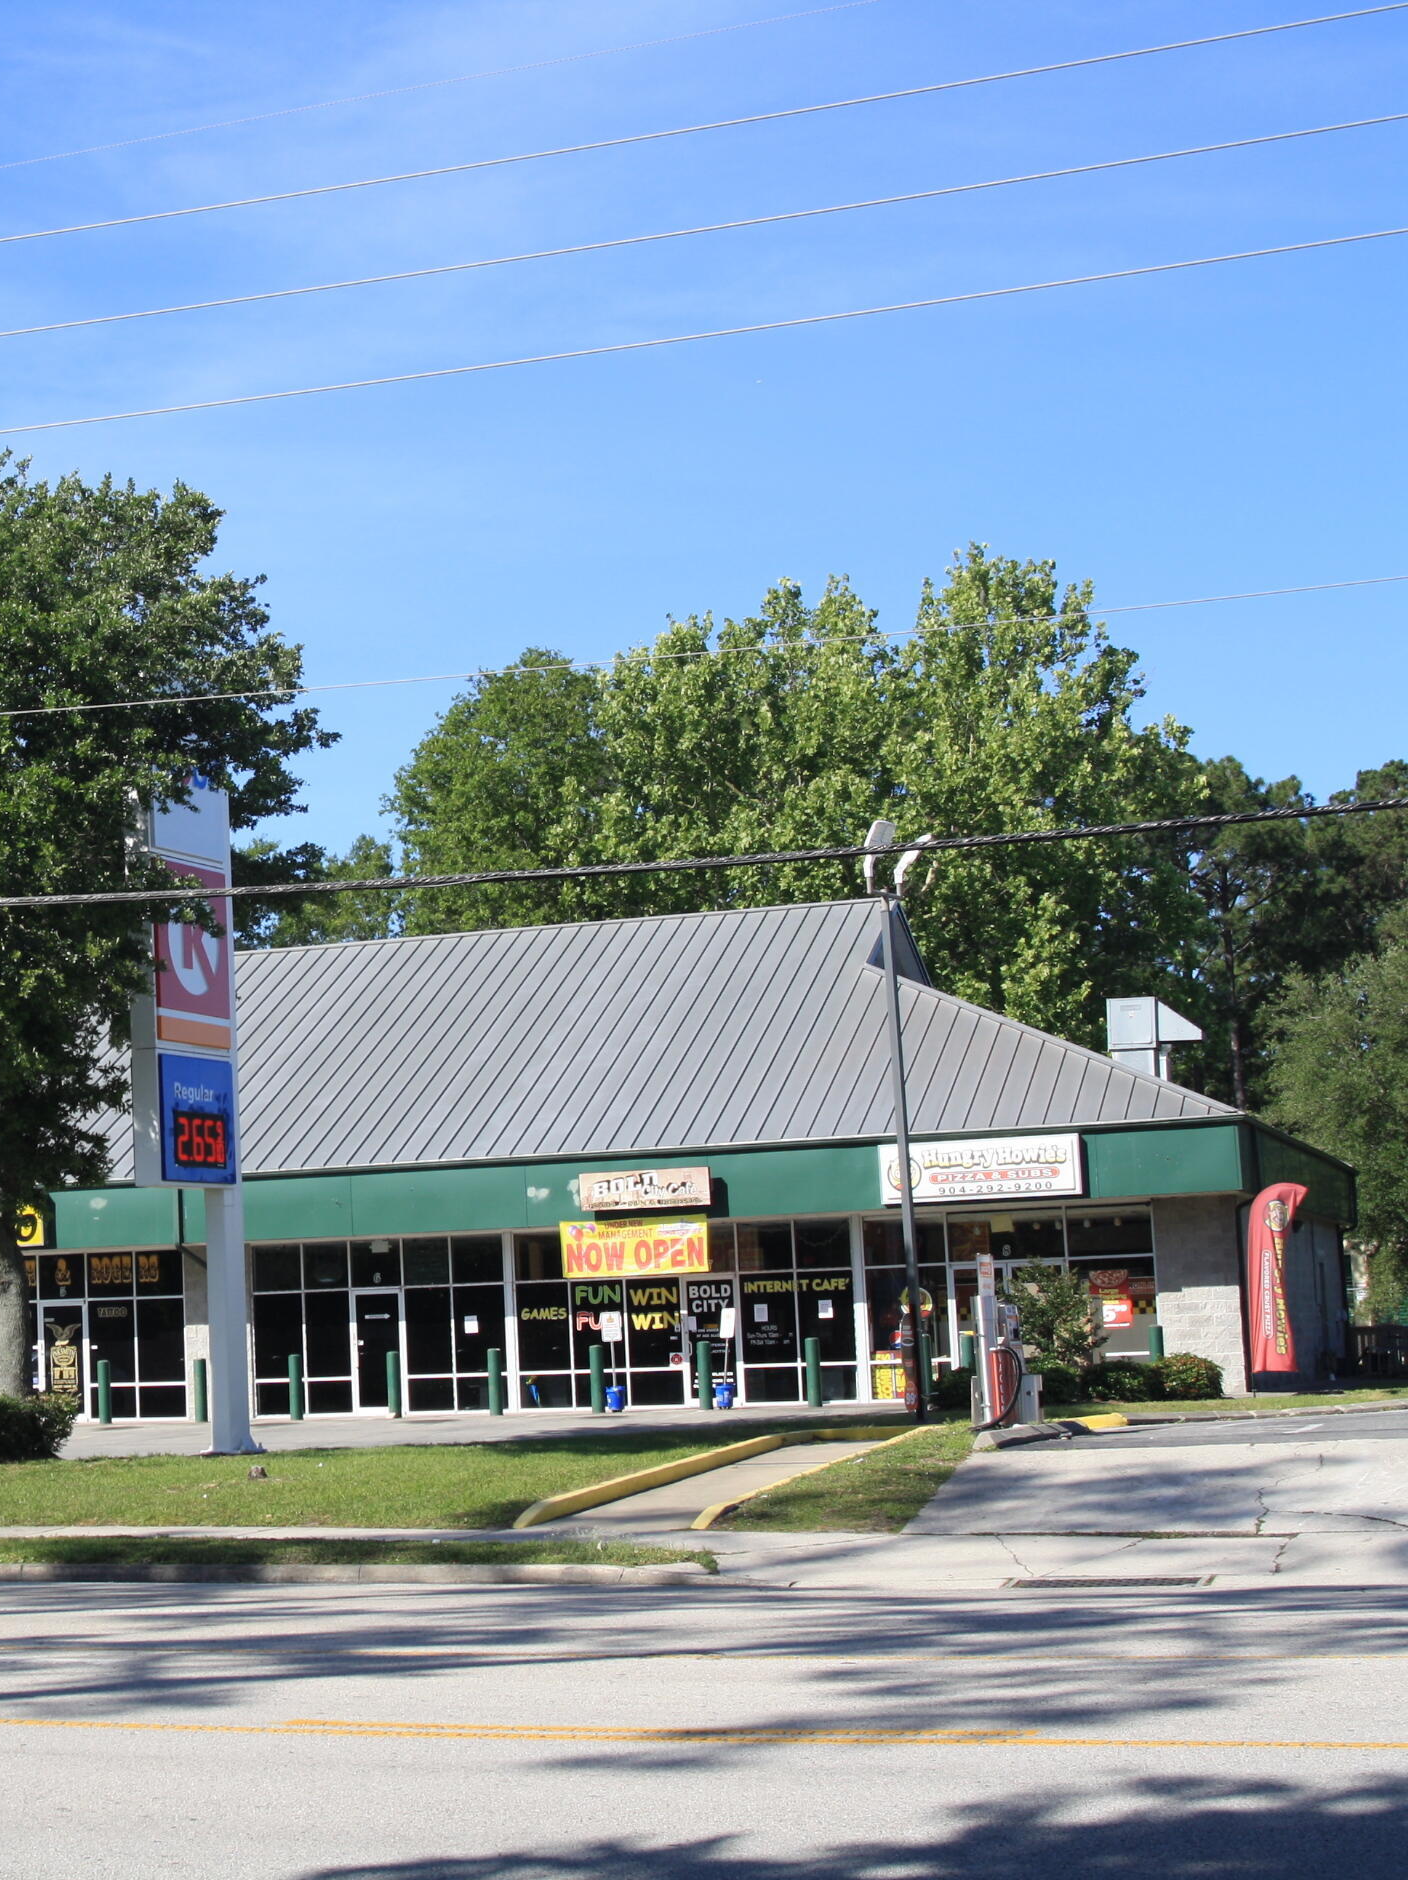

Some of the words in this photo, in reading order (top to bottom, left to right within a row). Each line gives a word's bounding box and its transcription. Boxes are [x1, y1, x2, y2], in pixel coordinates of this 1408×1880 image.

[174, 1082, 214, 1103] Regular
[922, 1149, 996, 1169] Hungry
[996, 1144, 1067, 1165] Howie's
[937, 1172, 985, 1183] PIZZA
[991, 1171, 1001, 1180] &
[1007, 1168, 1053, 1179] SUBS
[642, 1184, 667, 1198] City
[938, 1181, 1053, 1195] 904-292-9200
[598, 1228, 653, 1240] MANAGEMENT
[566, 1240, 625, 1273] NOW
[634, 1236, 705, 1270] OPEN
[1263, 1251, 1271, 1290] FLAVORED
[575, 1284, 621, 1306] FUN
[630, 1287, 679, 1306] WIN
[688, 1284, 731, 1299] BOLD
[521, 1307, 568, 1321] GAMES
[692, 1299, 729, 1313] CITY
[576, 1311, 618, 1331] FU
[632, 1311, 680, 1331] WIN
[1264, 1314, 1272, 1337] PIZZA
